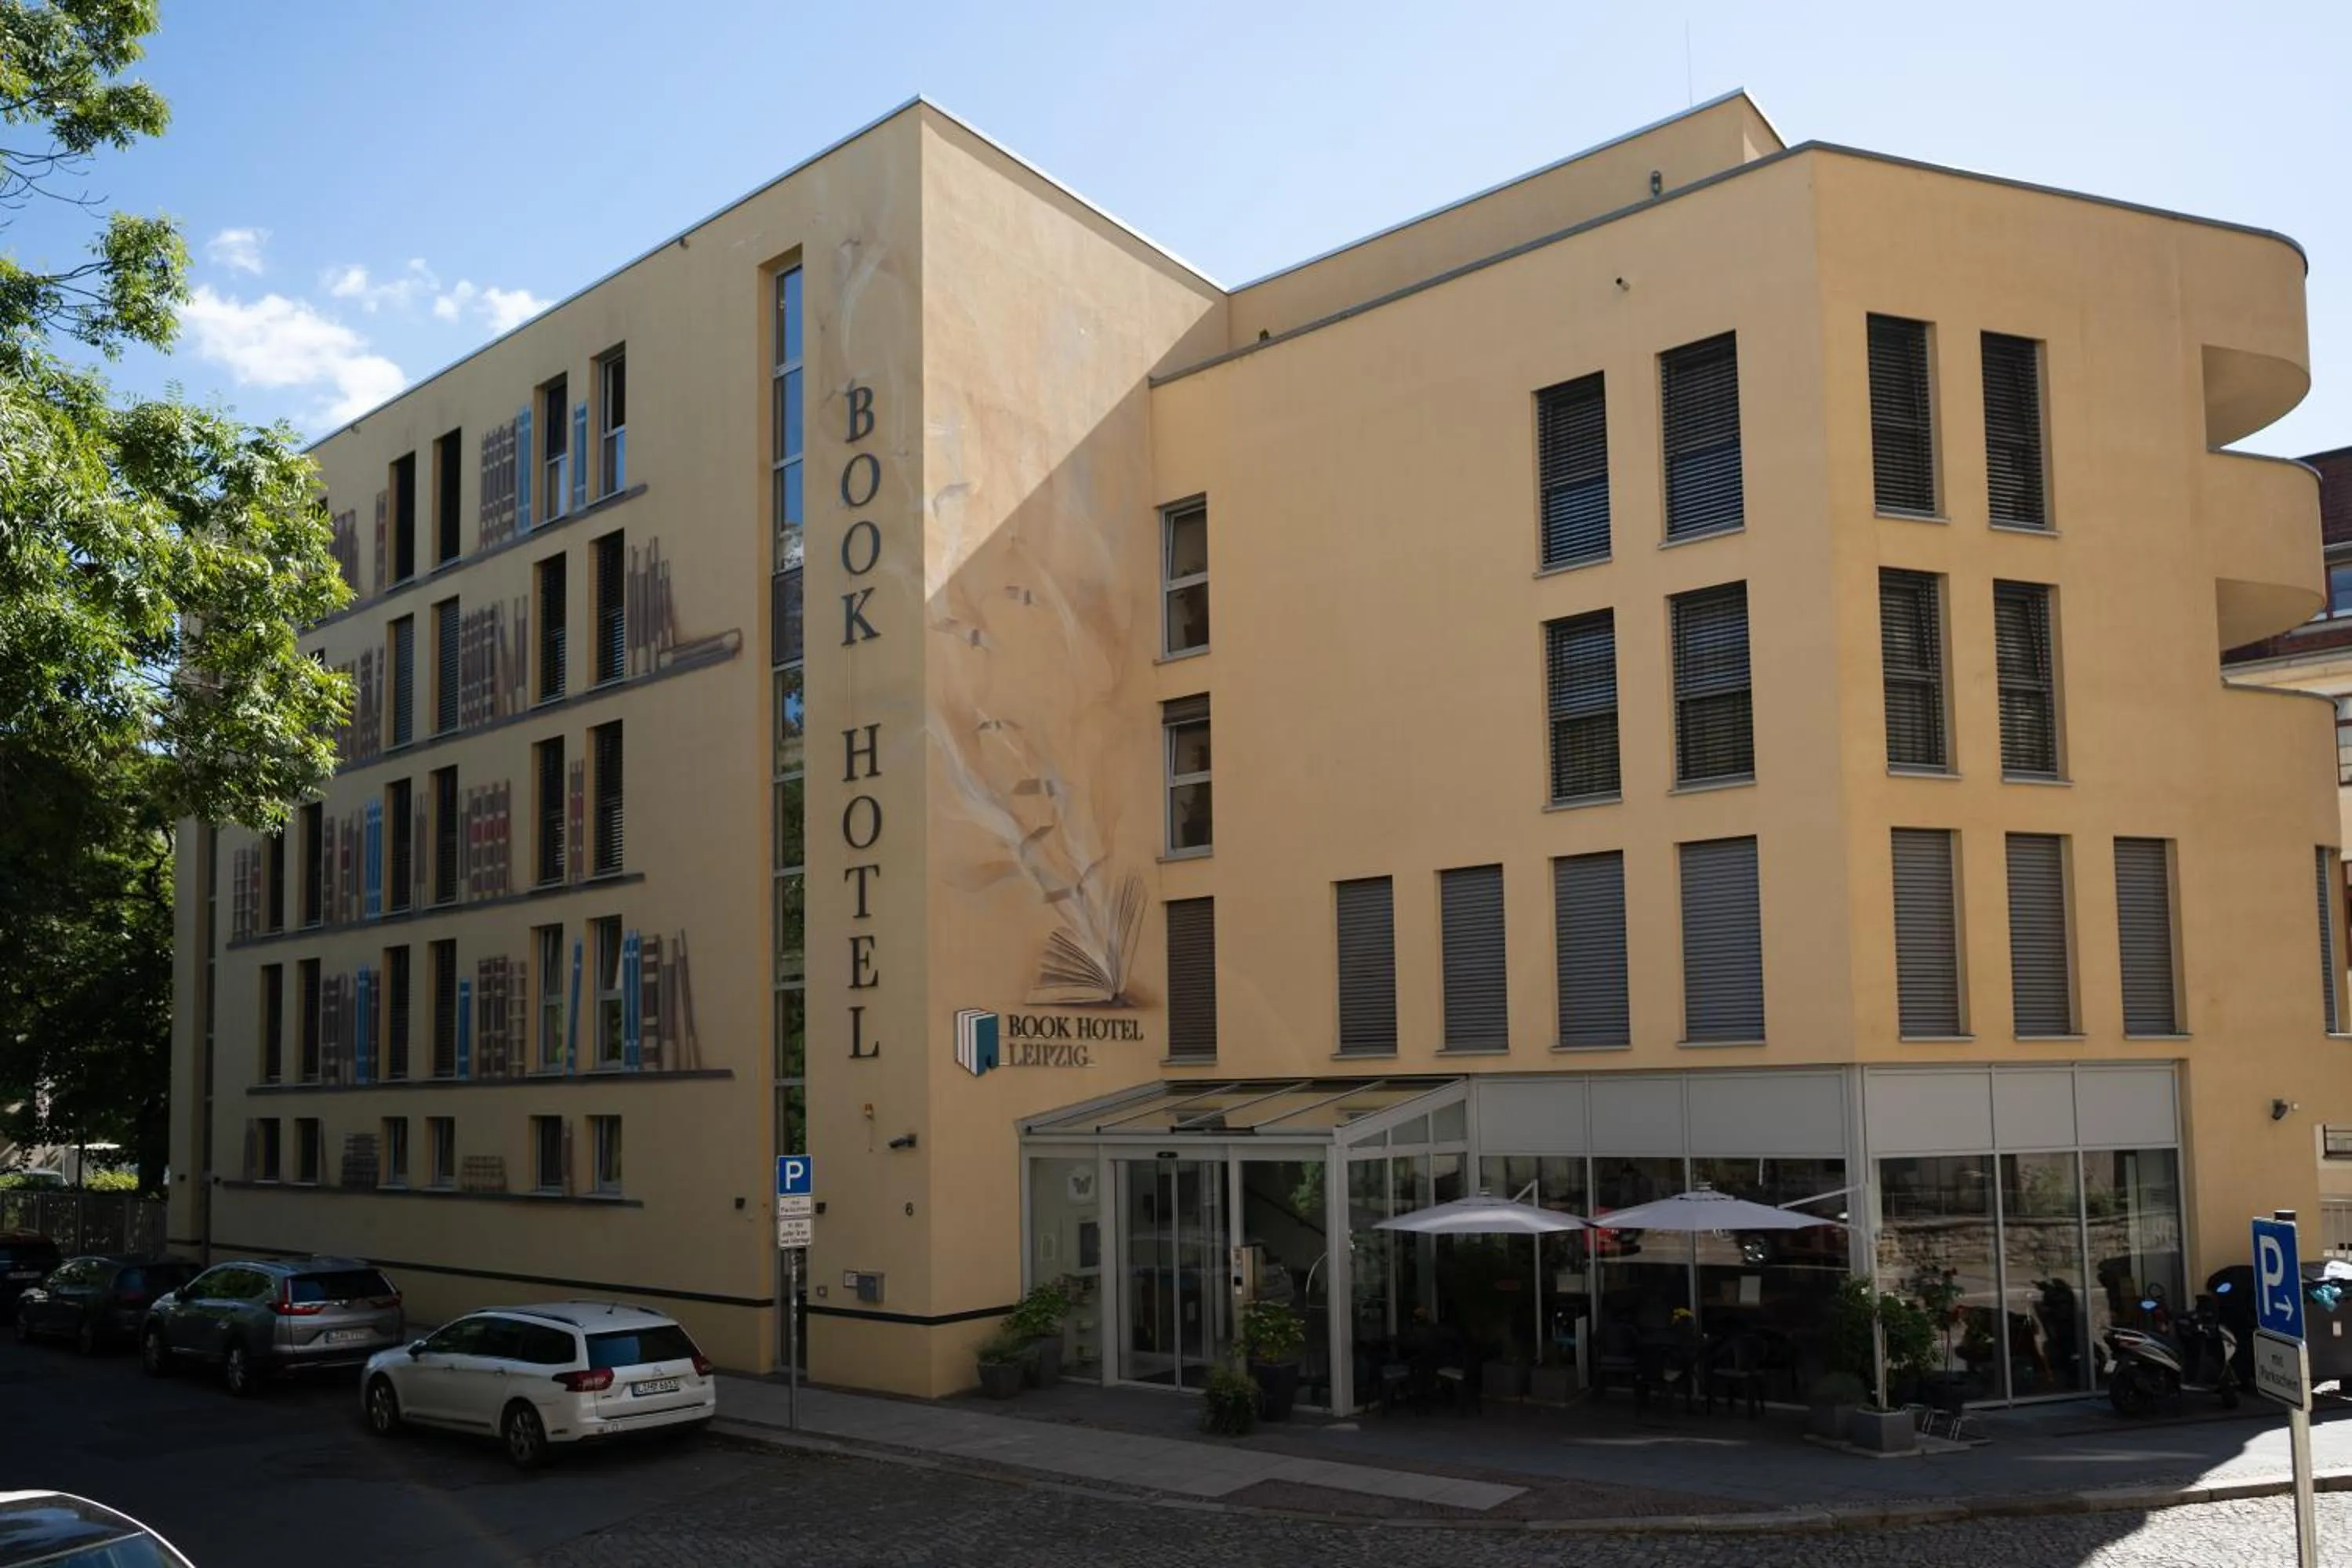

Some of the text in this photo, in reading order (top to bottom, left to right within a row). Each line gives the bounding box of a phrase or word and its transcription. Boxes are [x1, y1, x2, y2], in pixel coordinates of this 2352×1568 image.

[840, 385, 883, 1059] BOOK HOTEL
[1007, 1014, 1145, 1042] BOOK HOTEL
[1008, 1044, 1089, 1067] LEIPZIG
[785, 1160, 804, 1190] P
[2259, 1234, 2284, 1316] P
